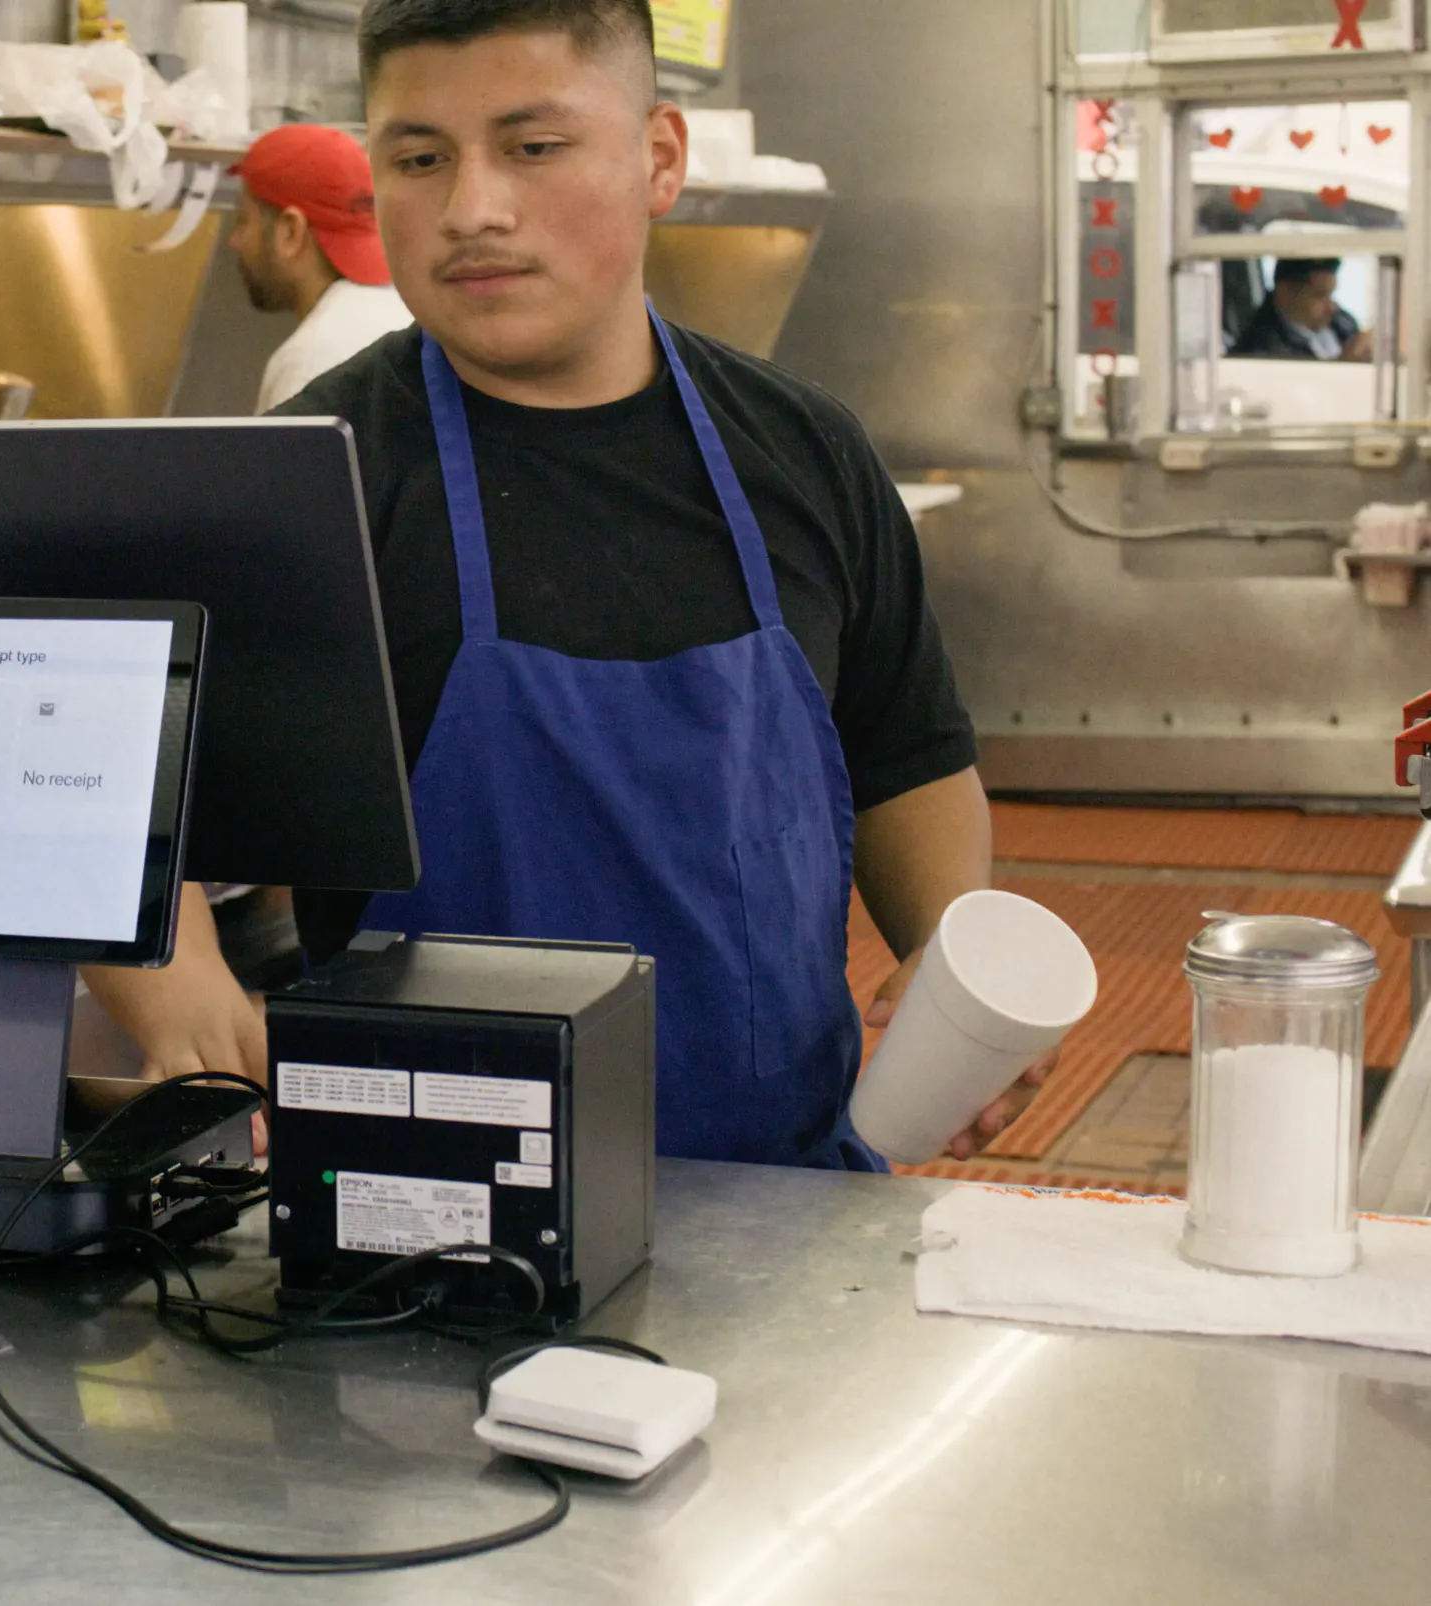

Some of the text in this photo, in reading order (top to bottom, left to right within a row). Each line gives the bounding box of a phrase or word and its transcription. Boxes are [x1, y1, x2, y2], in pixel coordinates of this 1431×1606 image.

[16, 650, 47, 666] type
[23, 770, 103, 791] No receipt
[340, 1178, 372, 1188] EPSON
